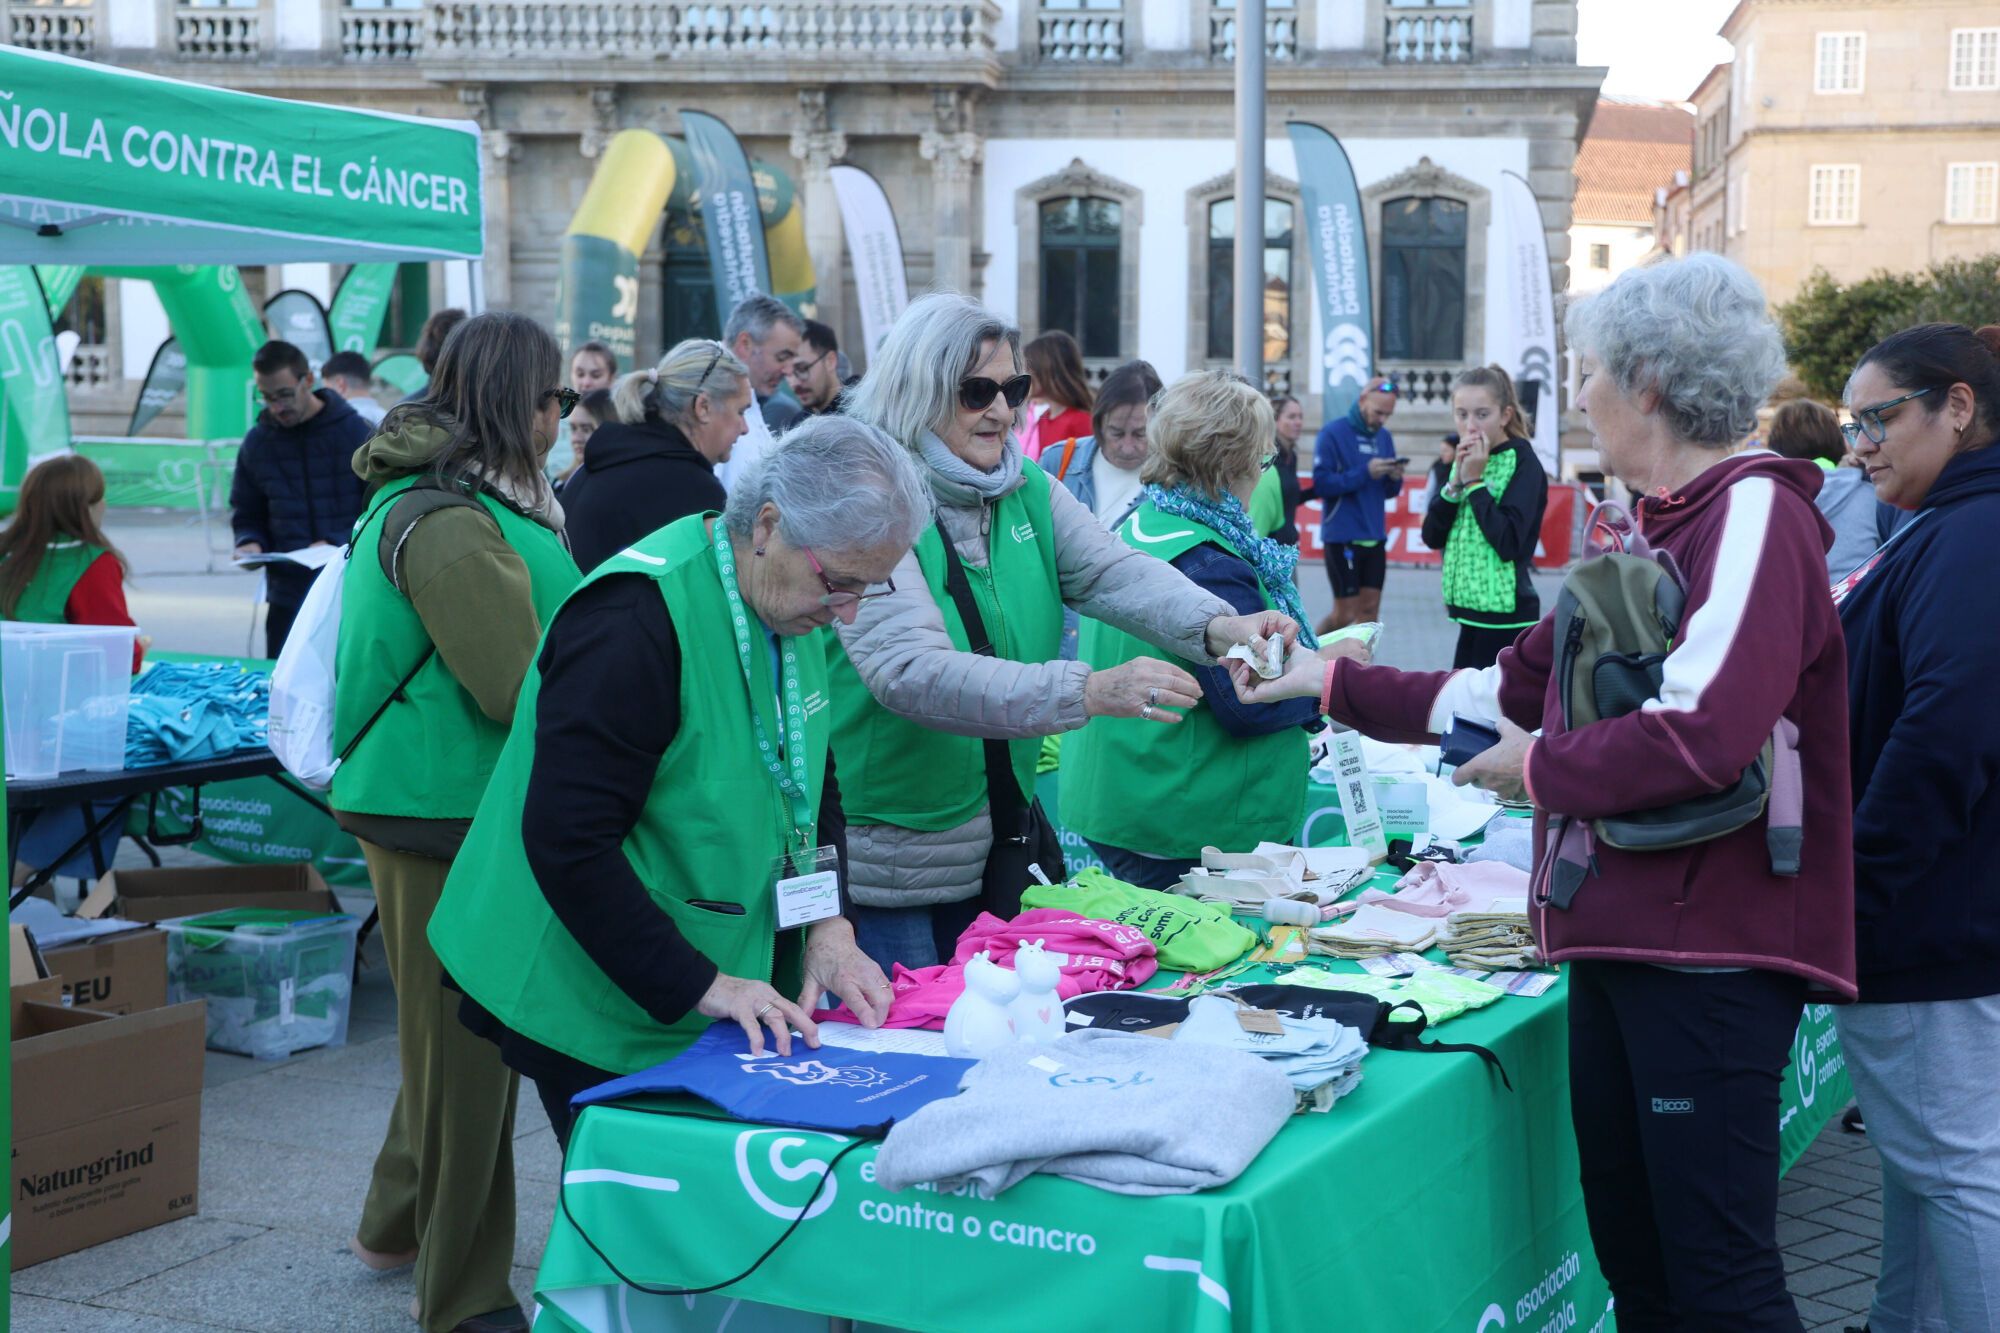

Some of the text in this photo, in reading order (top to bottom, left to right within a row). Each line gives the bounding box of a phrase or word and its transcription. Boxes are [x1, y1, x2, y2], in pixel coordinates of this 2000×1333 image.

[122, 125, 285, 190] CONTRA
[291, 153, 334, 197] EL
[339, 155, 469, 215] CÁNCER
[263, 842, 312, 859] cancro
[19, 1142, 154, 1201] Naturgrind
[859, 1200, 1097, 1256] contra o cancro
[1516, 1250, 1580, 1325] asociación
